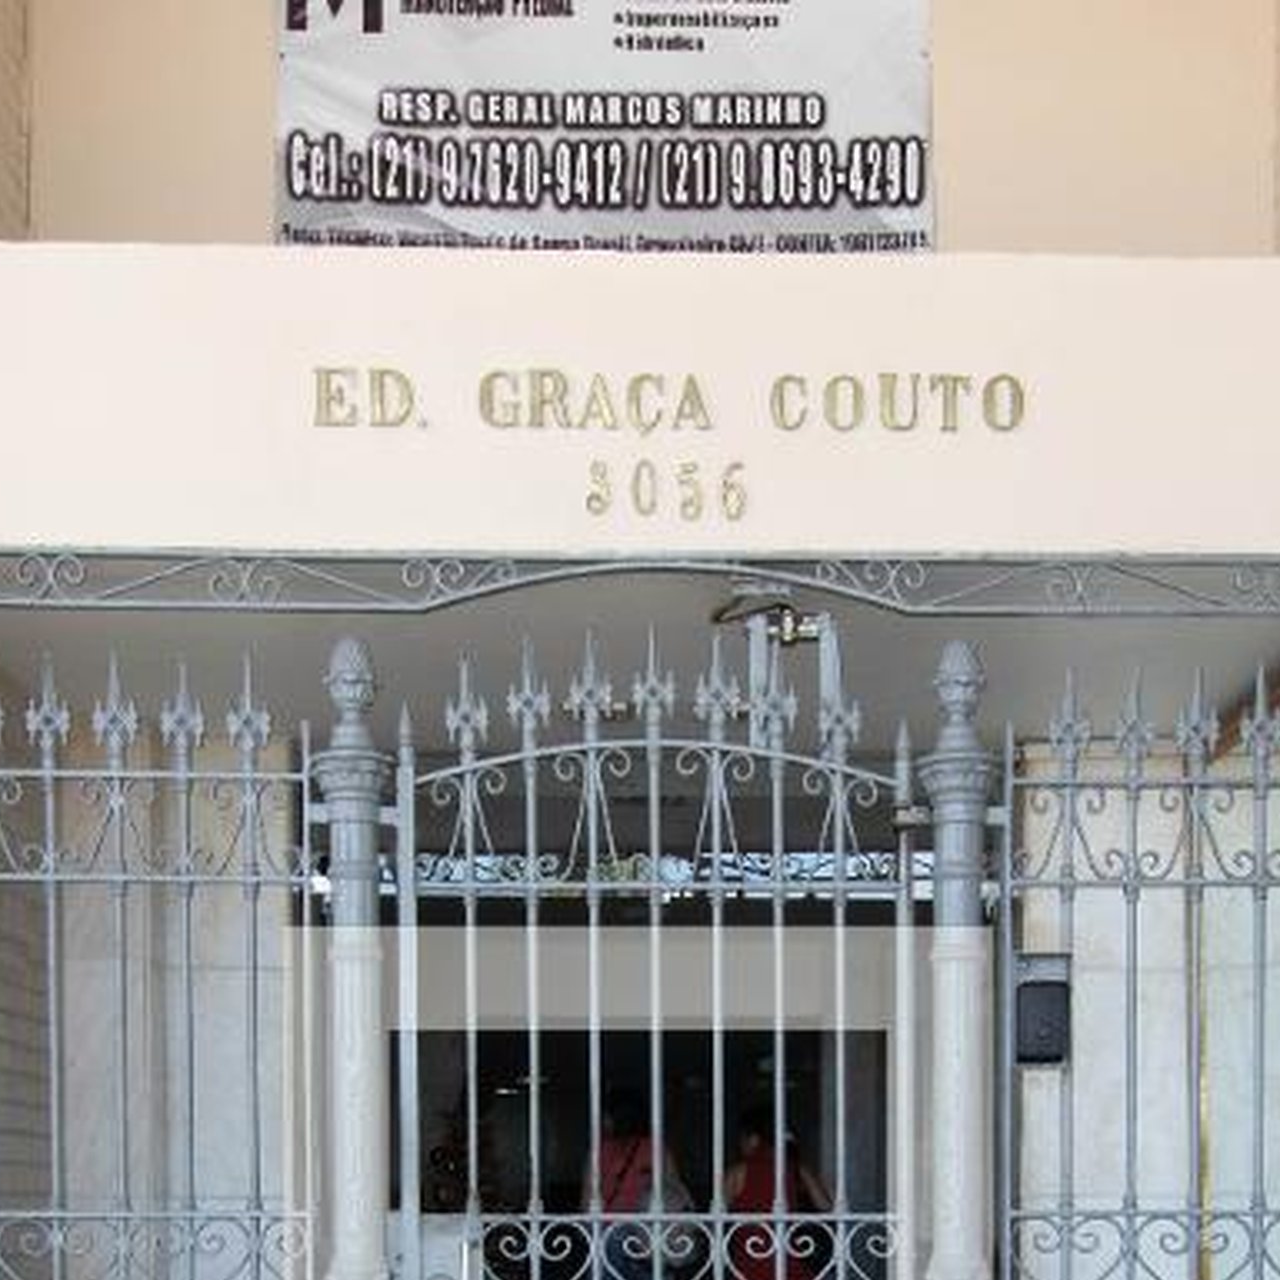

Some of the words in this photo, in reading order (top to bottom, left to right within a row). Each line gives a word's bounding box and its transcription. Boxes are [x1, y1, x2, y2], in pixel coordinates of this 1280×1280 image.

[380, 89, 460, 124] RESP.
[467, 90, 557, 127] GERAL
[564, 91, 684, 127] MARCOS
[690, 91, 825, 128] MARINHO
[370, 133, 431, 203] (21)
[657, 137, 721, 207] (21)
[312, 366, 428, 429] ED.
[476, 368, 714, 438] GRAÇA
[768, 372, 1026, 433] COUTO
